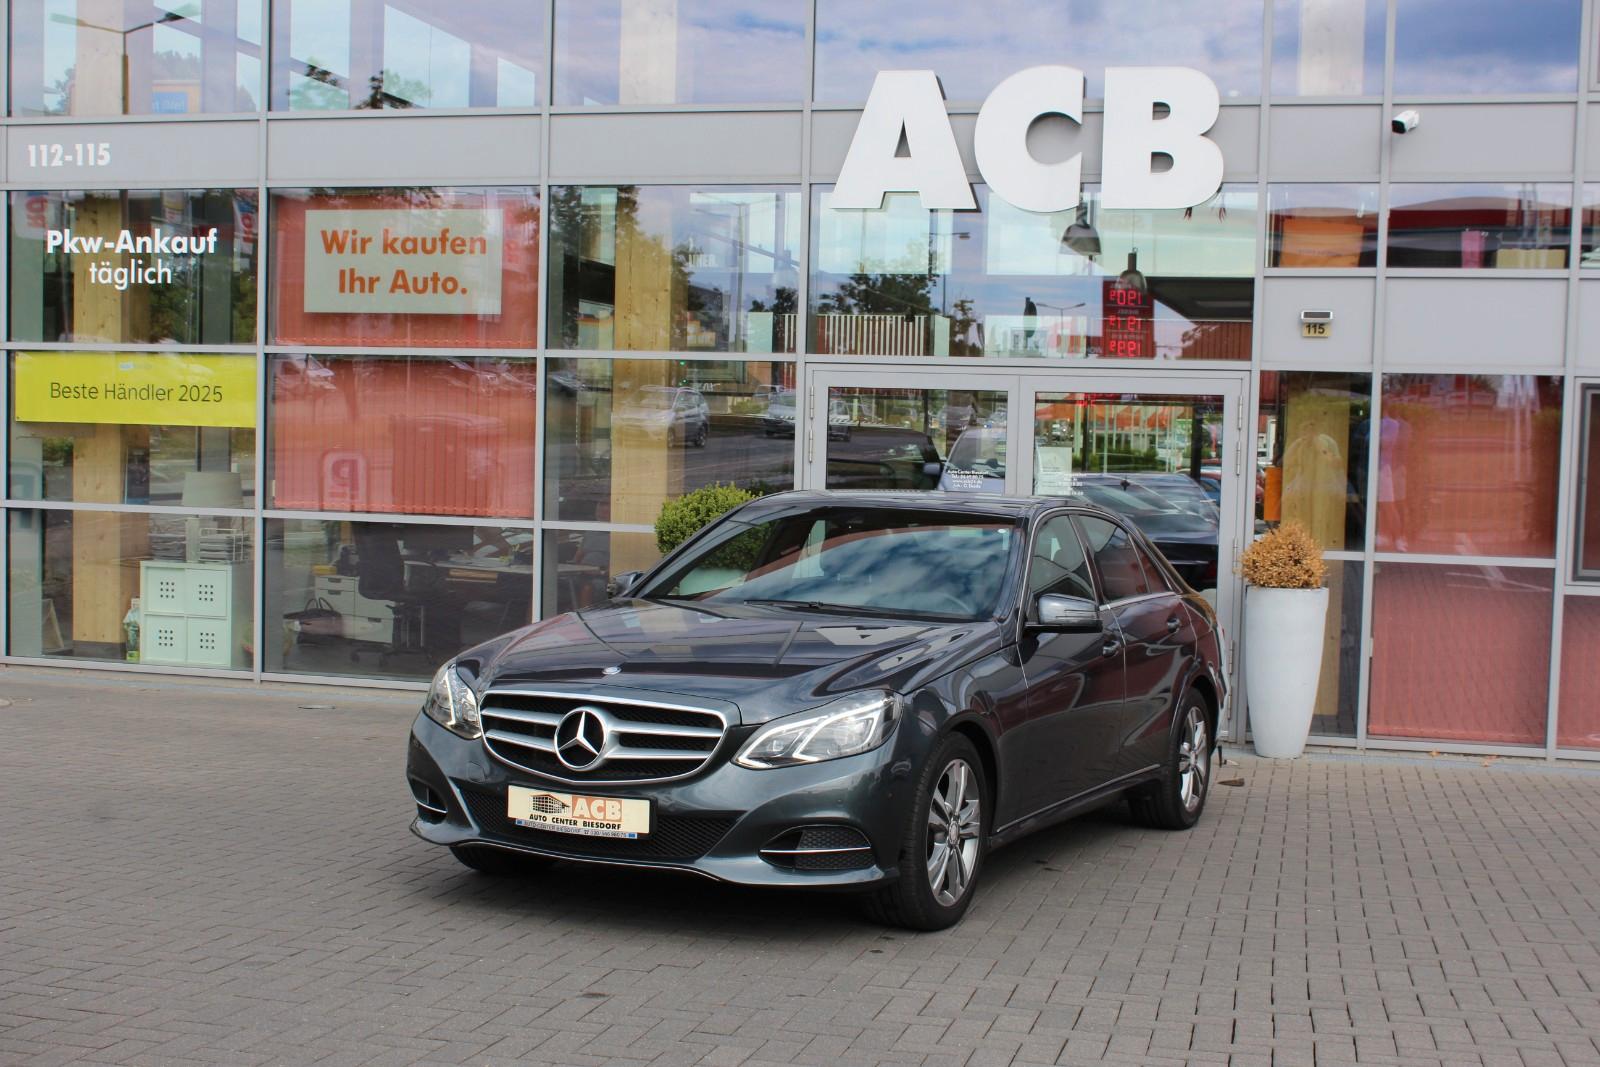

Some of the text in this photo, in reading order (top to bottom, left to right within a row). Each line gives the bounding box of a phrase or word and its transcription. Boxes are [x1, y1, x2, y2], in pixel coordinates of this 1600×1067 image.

[830, 65, 1224, 213] ACB
[28, 143, 111, 167] 112-115
[47, 227, 218, 254] Pkw-Ankauf
[320, 228, 487, 255] Wir kaufen
[89, 258, 172, 291] täglich
[338, 267, 468, 295] Ihr Auto.
[1305, 323, 1326, 335] 115
[50, 382, 223, 402] Beste Händler 2025
[529, 813, 622, 830] AUTO CENTER BIESDORF
[572, 798, 621, 820] ACB
